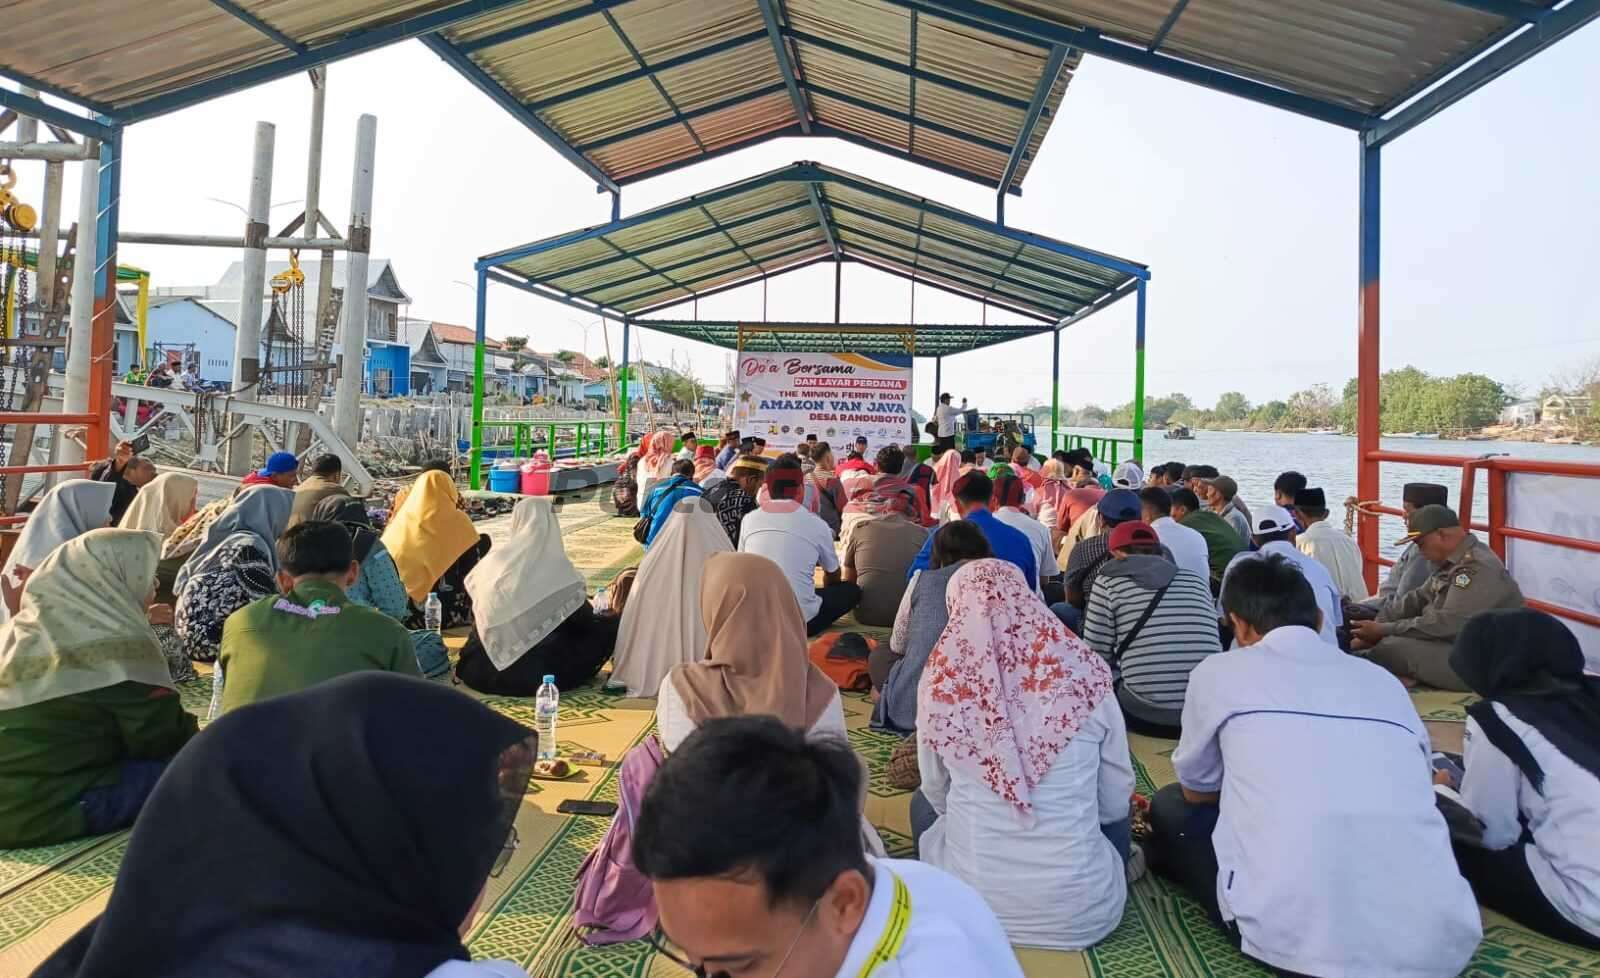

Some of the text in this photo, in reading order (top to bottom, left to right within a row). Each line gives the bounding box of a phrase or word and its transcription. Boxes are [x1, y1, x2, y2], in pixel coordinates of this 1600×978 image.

[783, 358, 856, 375] Bersama
[794, 378, 902, 389] DAN LAYAR PERDANA
[778, 390, 907, 401] THE MINION FERRY BOAT
[759, 400, 907, 414] AMAZON VAN JAVA
[809, 413, 907, 424] DESA RANDUBOTO
